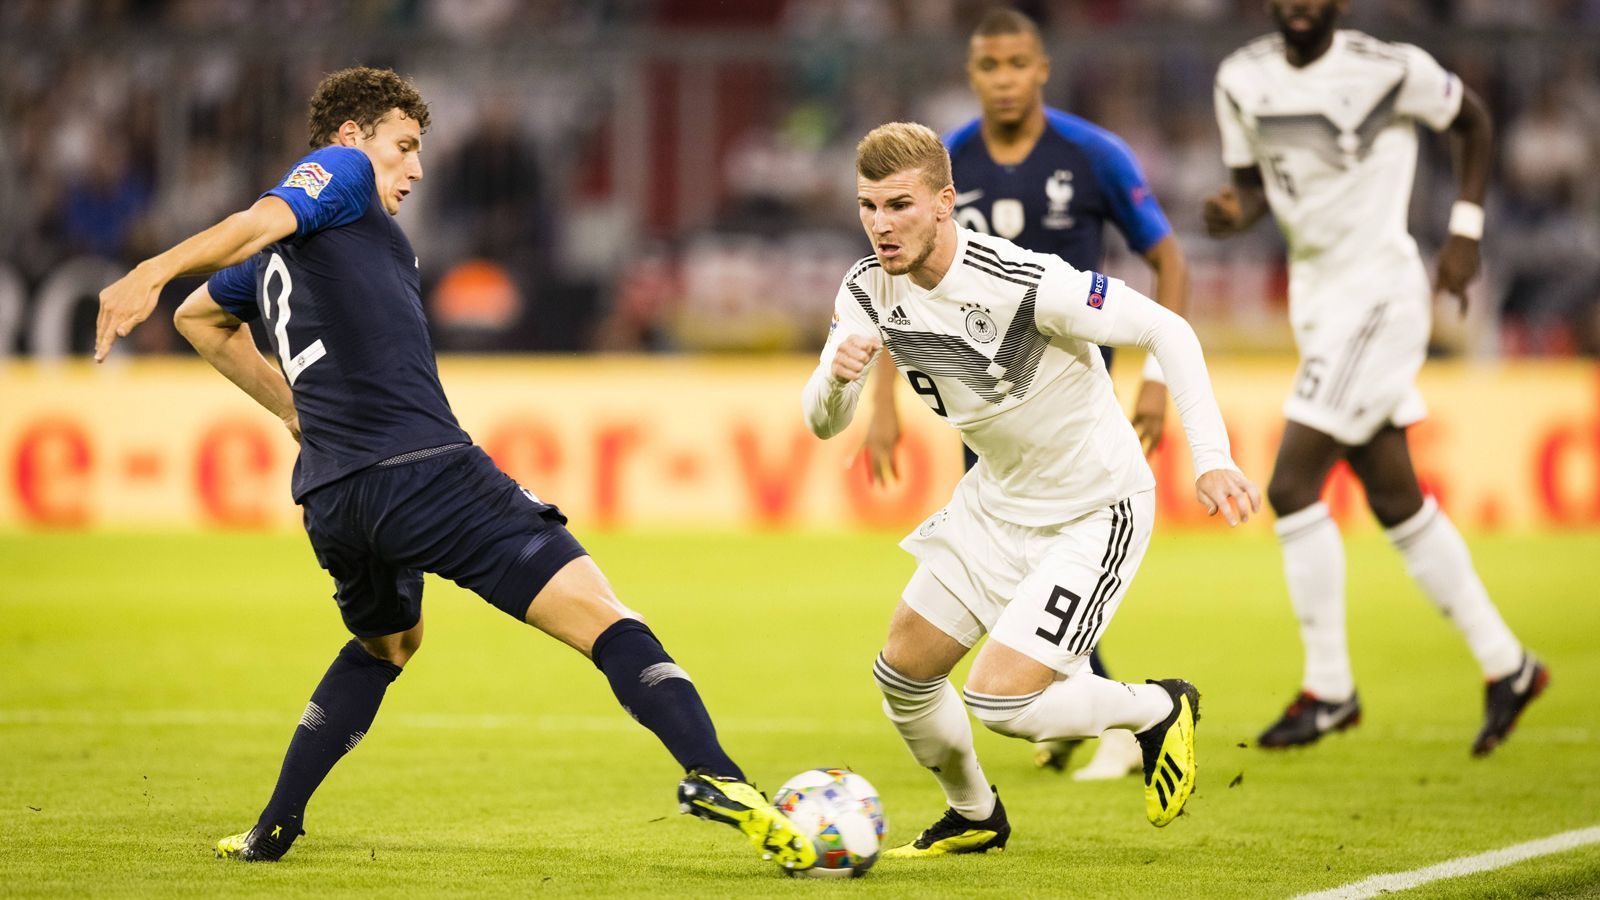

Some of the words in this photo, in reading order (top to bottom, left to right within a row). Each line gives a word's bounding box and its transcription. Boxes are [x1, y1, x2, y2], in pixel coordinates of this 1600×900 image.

[263, 252, 327, 387] 2
[906, 370, 948, 418] 9
[1035, 584, 1082, 647] 9
